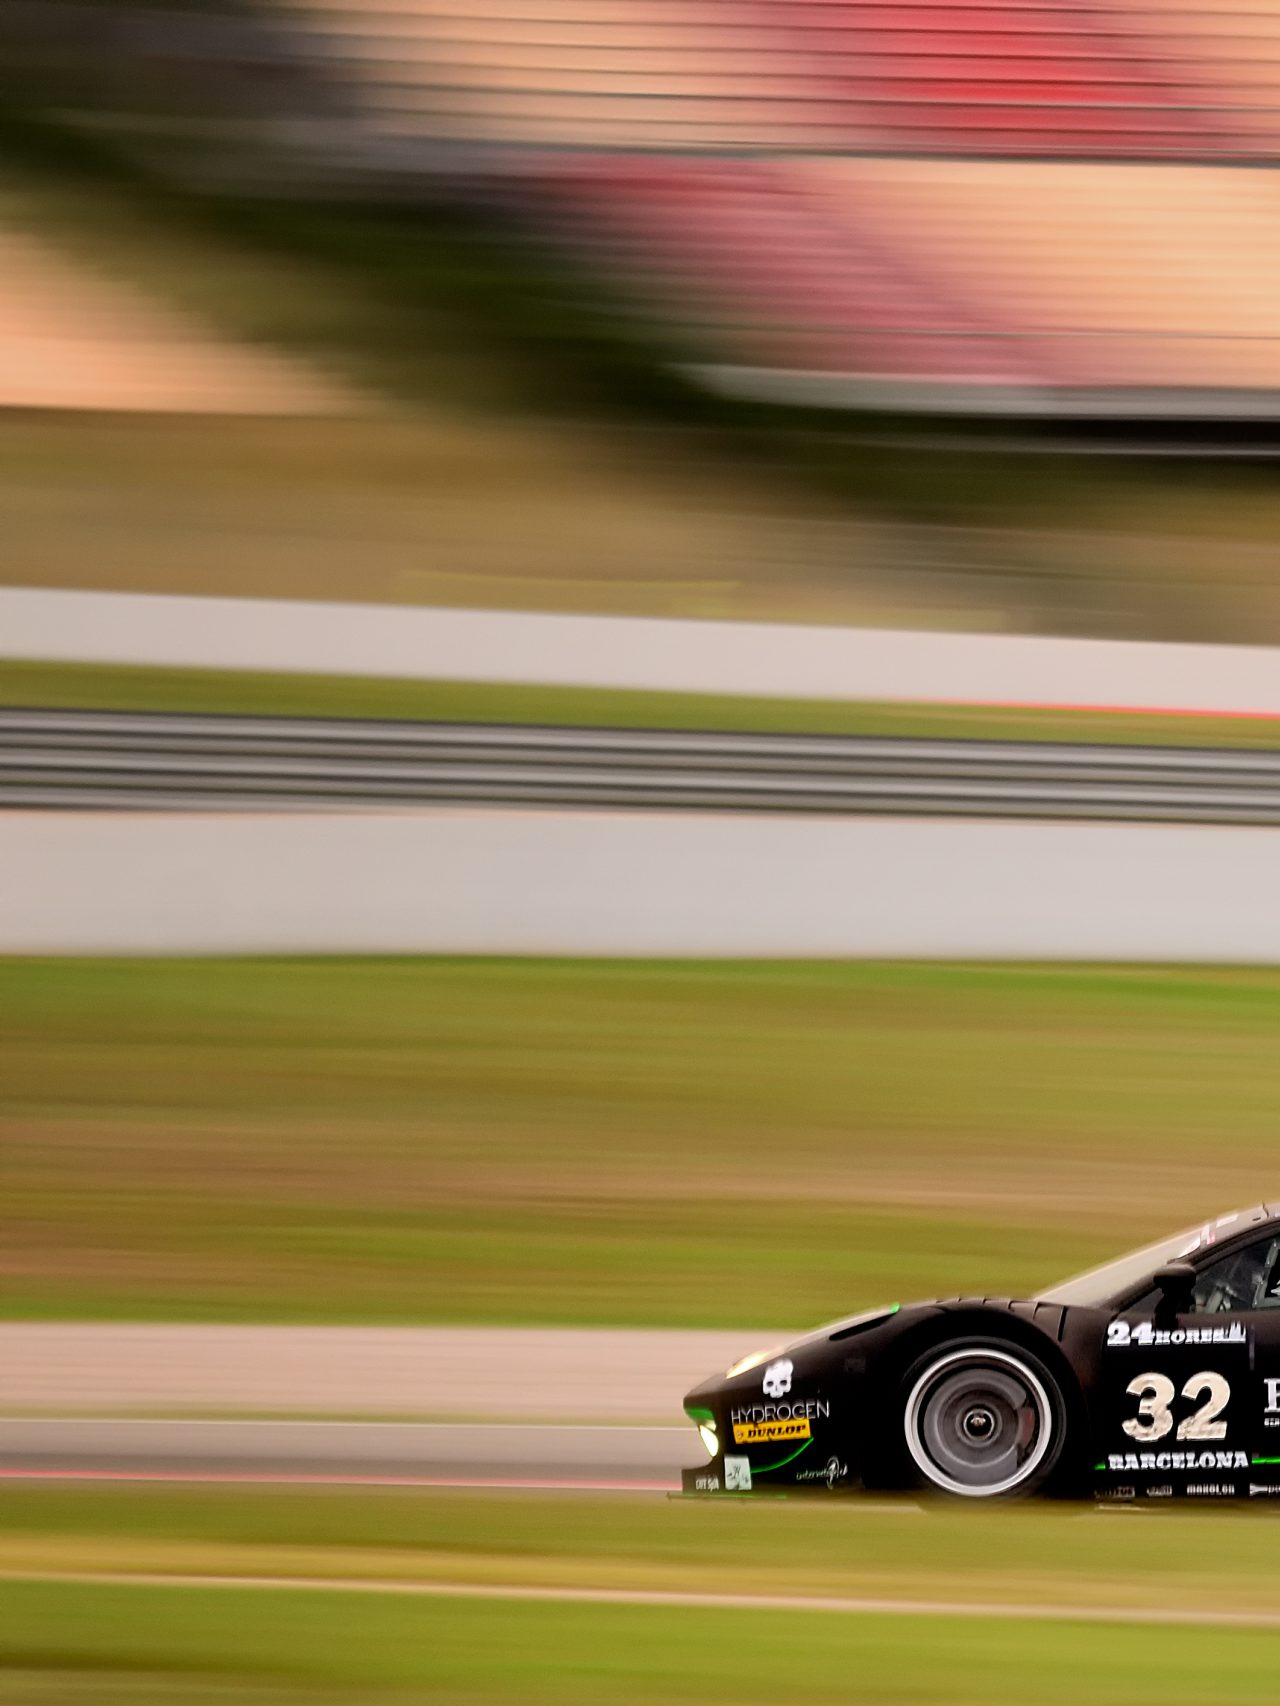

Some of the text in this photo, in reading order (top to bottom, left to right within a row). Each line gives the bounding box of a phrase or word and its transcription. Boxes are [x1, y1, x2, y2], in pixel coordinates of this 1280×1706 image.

[731, 1399, 830, 1425] HYDROGEN
[1121, 1371, 1232, 1443] 32
[746, 1424, 806, 1439] DUNLOP
[1108, 1451, 1249, 1471] BARCELONA
